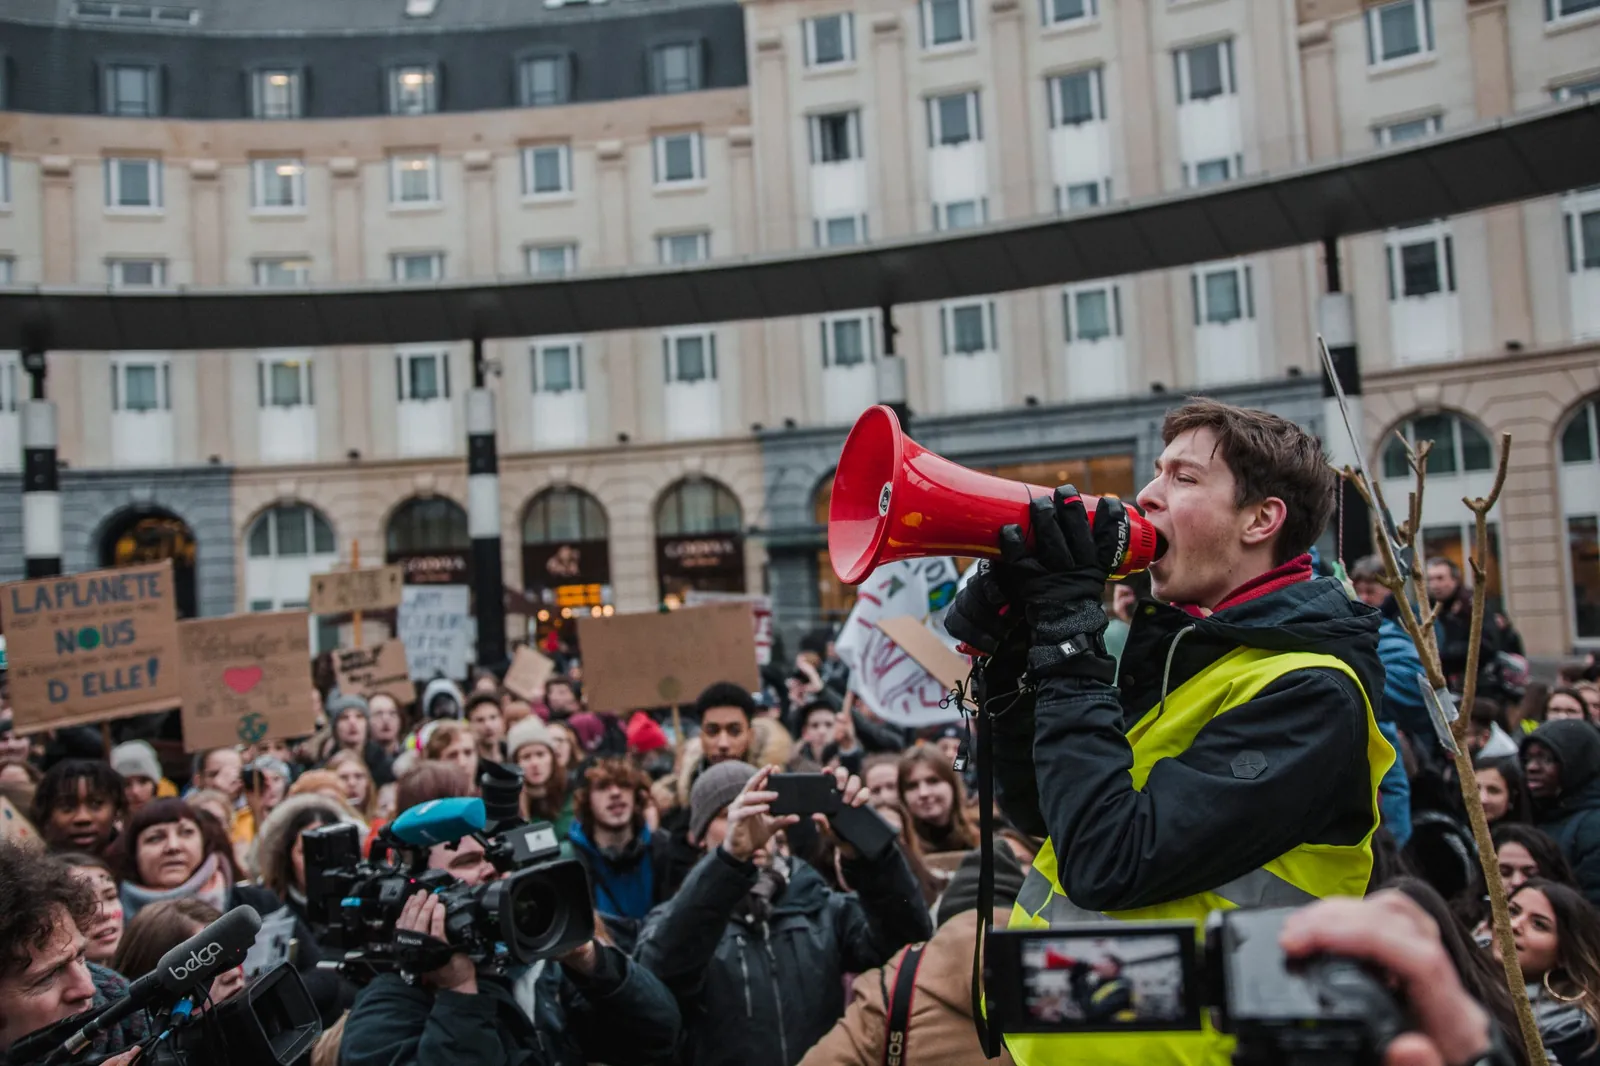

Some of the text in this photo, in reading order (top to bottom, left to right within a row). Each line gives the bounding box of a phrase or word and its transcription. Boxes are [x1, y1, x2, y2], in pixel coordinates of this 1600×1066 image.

[1111, 520, 1126, 567] NEVICA
[55, 618, 136, 656] NOUS
[168, 942, 224, 980] belga
